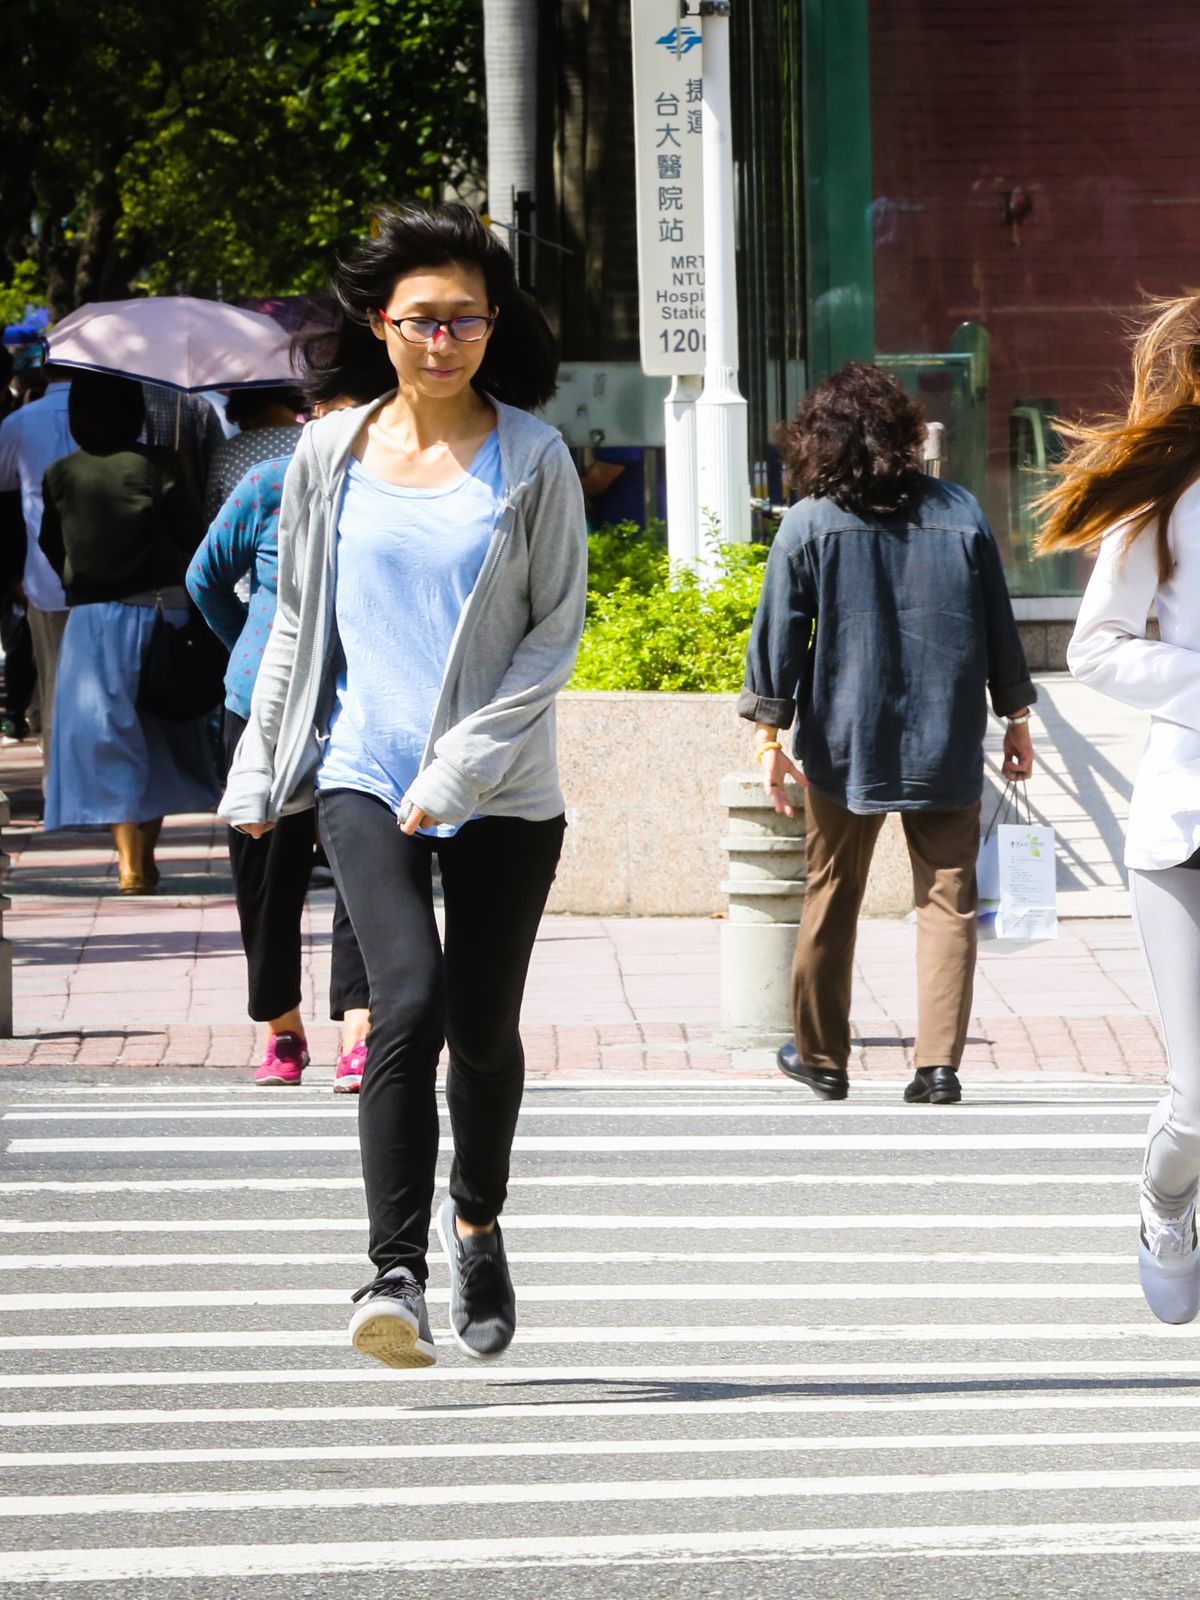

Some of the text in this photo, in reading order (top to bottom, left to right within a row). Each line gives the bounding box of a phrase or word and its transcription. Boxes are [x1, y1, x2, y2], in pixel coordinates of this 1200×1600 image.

[655, 91, 684, 243] 台大醫院站
[673, 272, 705, 286] NTU
[656, 289, 705, 304] Hospi
[661, 306, 706, 320] Statio
[659, 328, 706, 353] 120
